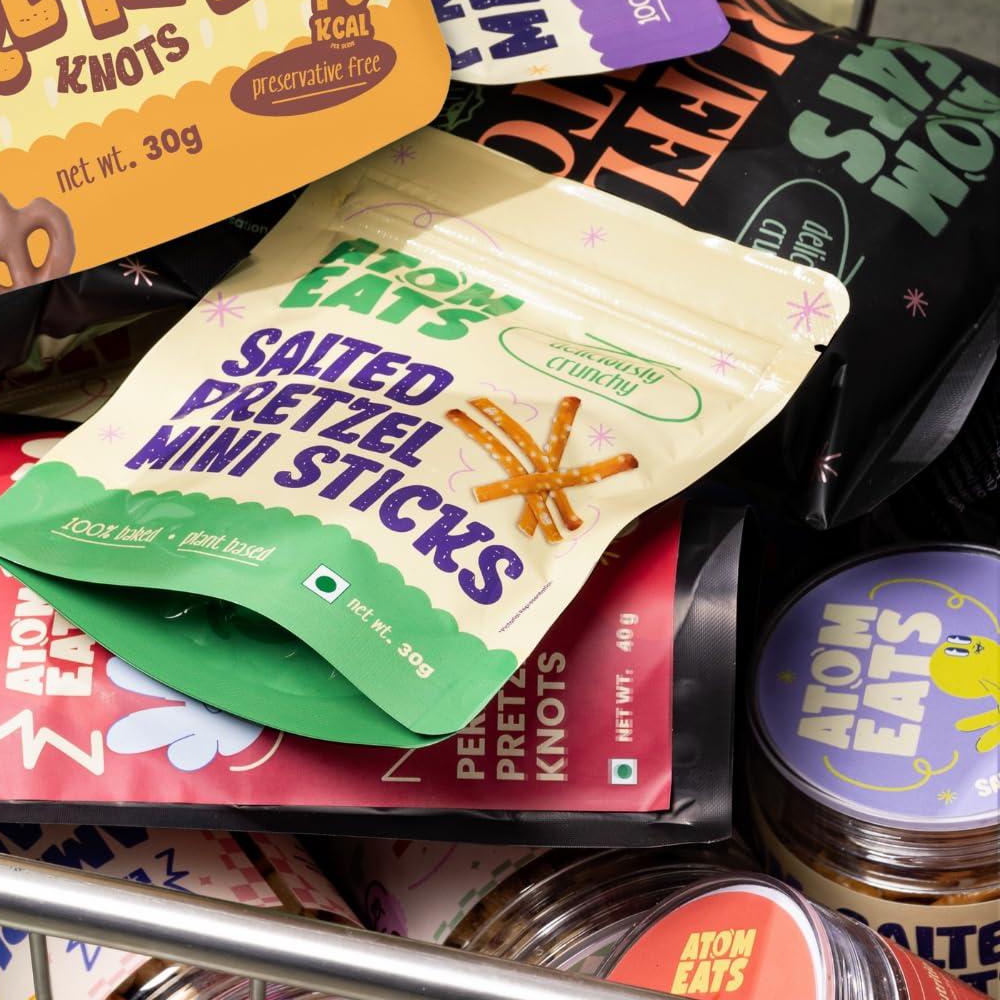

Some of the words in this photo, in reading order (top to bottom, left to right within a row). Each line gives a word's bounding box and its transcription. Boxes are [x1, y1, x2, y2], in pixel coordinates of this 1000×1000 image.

[56, 22, 190, 94] KNOTS
[312, 13, 373, 42] KCAL
[252, 61, 343, 100] preservative
[348, 55, 381, 77] free
[789, 38, 962, 184] EATS
[56, 158, 95, 193] net
[97, 146, 137, 178] wt.
[142, 124, 203, 160] 30g
[280, 266, 490, 340] EATS
[320, 237, 525, 317] ATOM
[221, 327, 454, 406] SALTED
[546, 356, 639, 396] crunchy
[170, 378, 443, 468] PRETZEL
[61, 517, 117, 539] 100%
[115, 525, 163, 543] baked
[179, 530, 226, 550] plant
[224, 537, 276, 561] based
[124, 425, 281, 477] MINI
[274, 445, 524, 605] STICKS
[346, 598, 374, 623] net
[370, 618, 392, 645] wt.
[397, 642, 436, 679] 30g
[797, 603, 878, 751] ATOM
[853, 608, 942, 757] EATS
[536, 652, 568, 782] KNOTS
[616, 719, 633, 742] NET
[671, 957, 748, 995] EATS
[680, 927, 757, 961] ATOM
